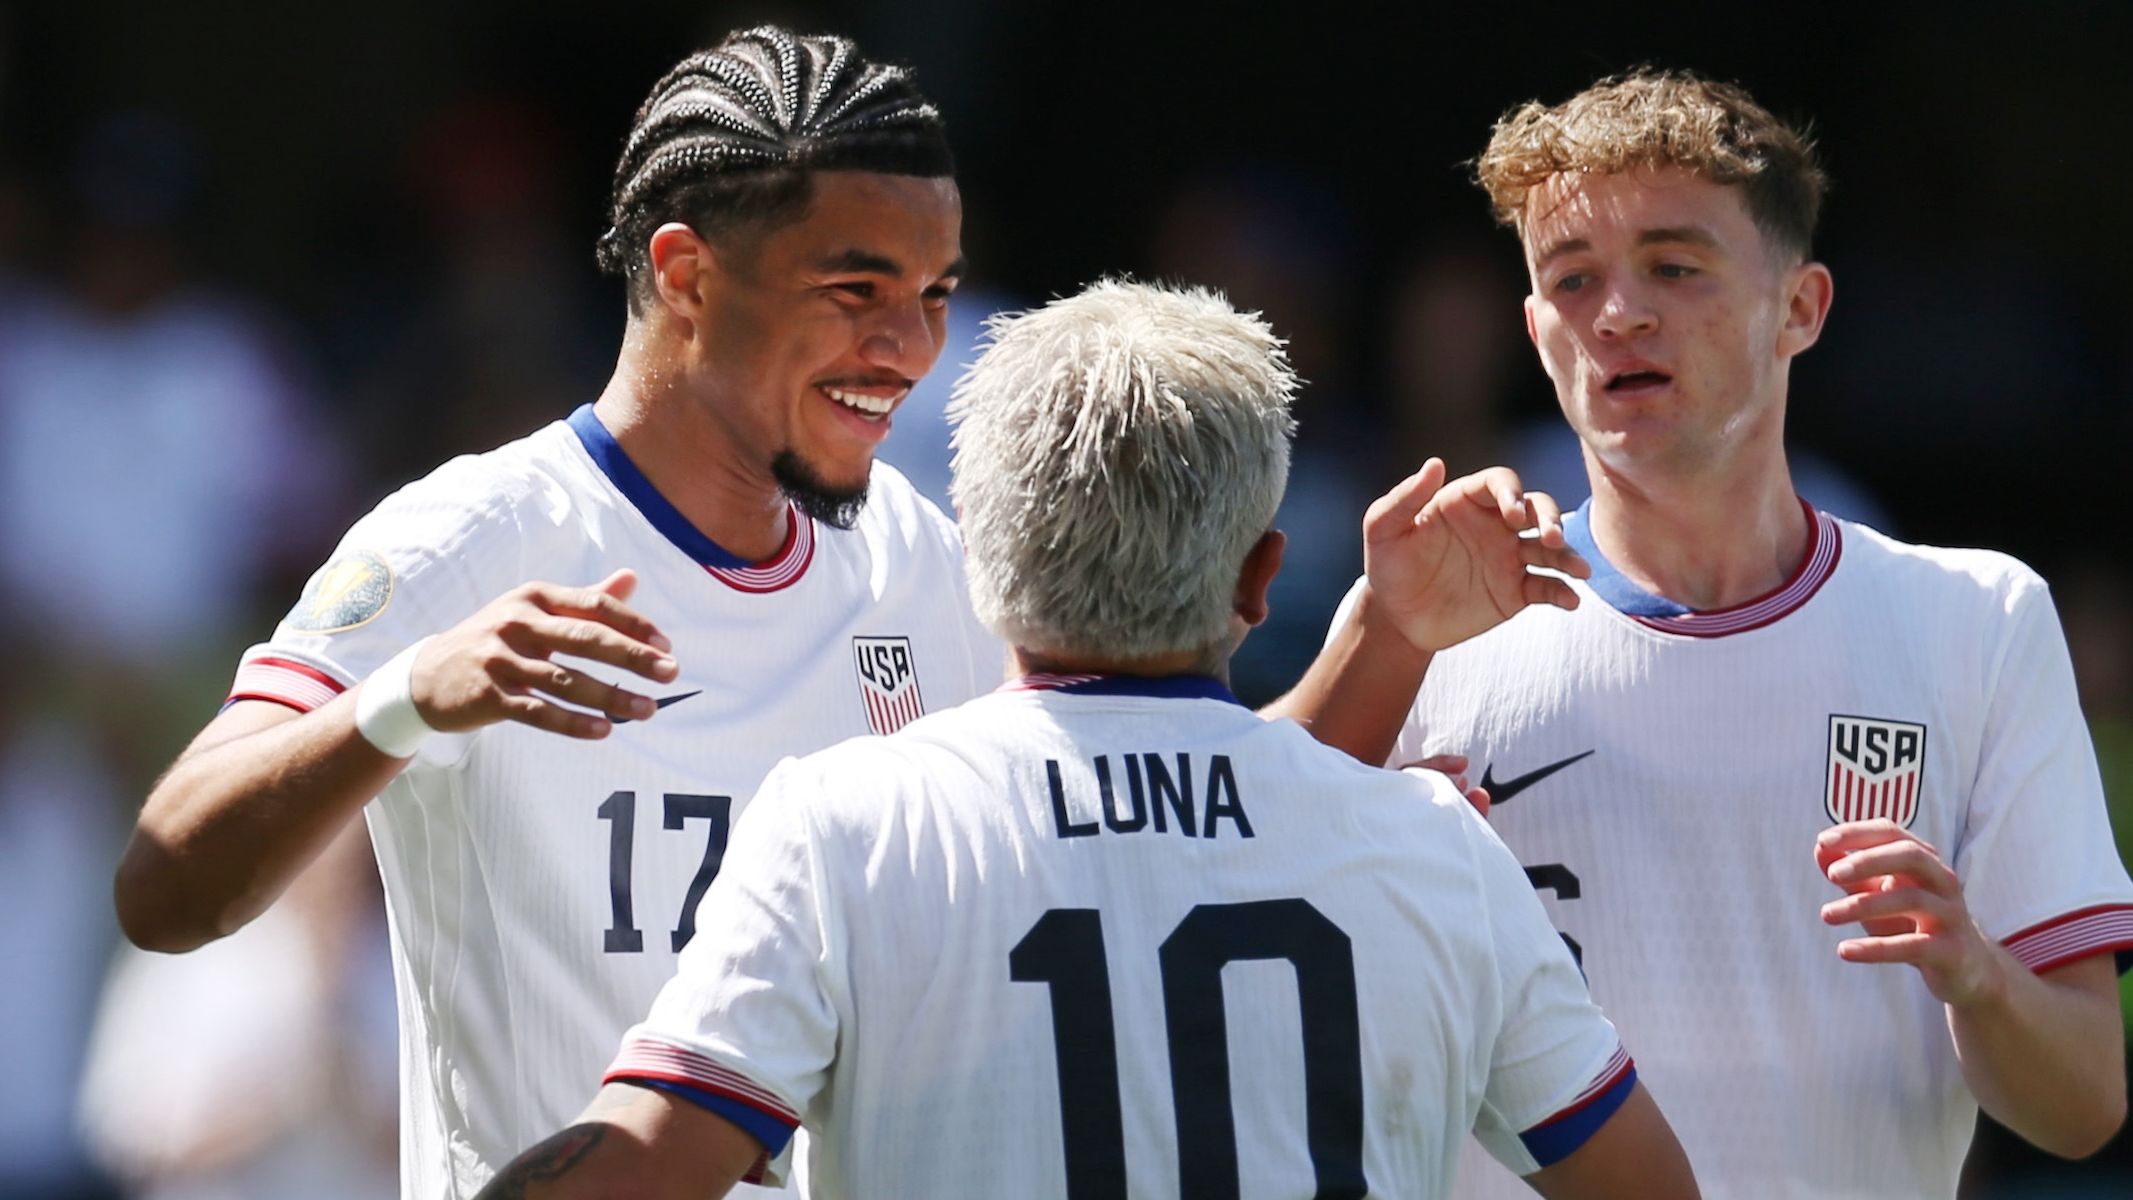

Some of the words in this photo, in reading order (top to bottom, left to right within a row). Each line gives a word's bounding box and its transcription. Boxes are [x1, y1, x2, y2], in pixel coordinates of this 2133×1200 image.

[857, 645, 909, 692] USA
[1836, 723, 1918, 775] USA
[1045, 752, 1255, 839] LUNA
[597, 791, 732, 953] 17
[1009, 897, 1368, 1200] 10
